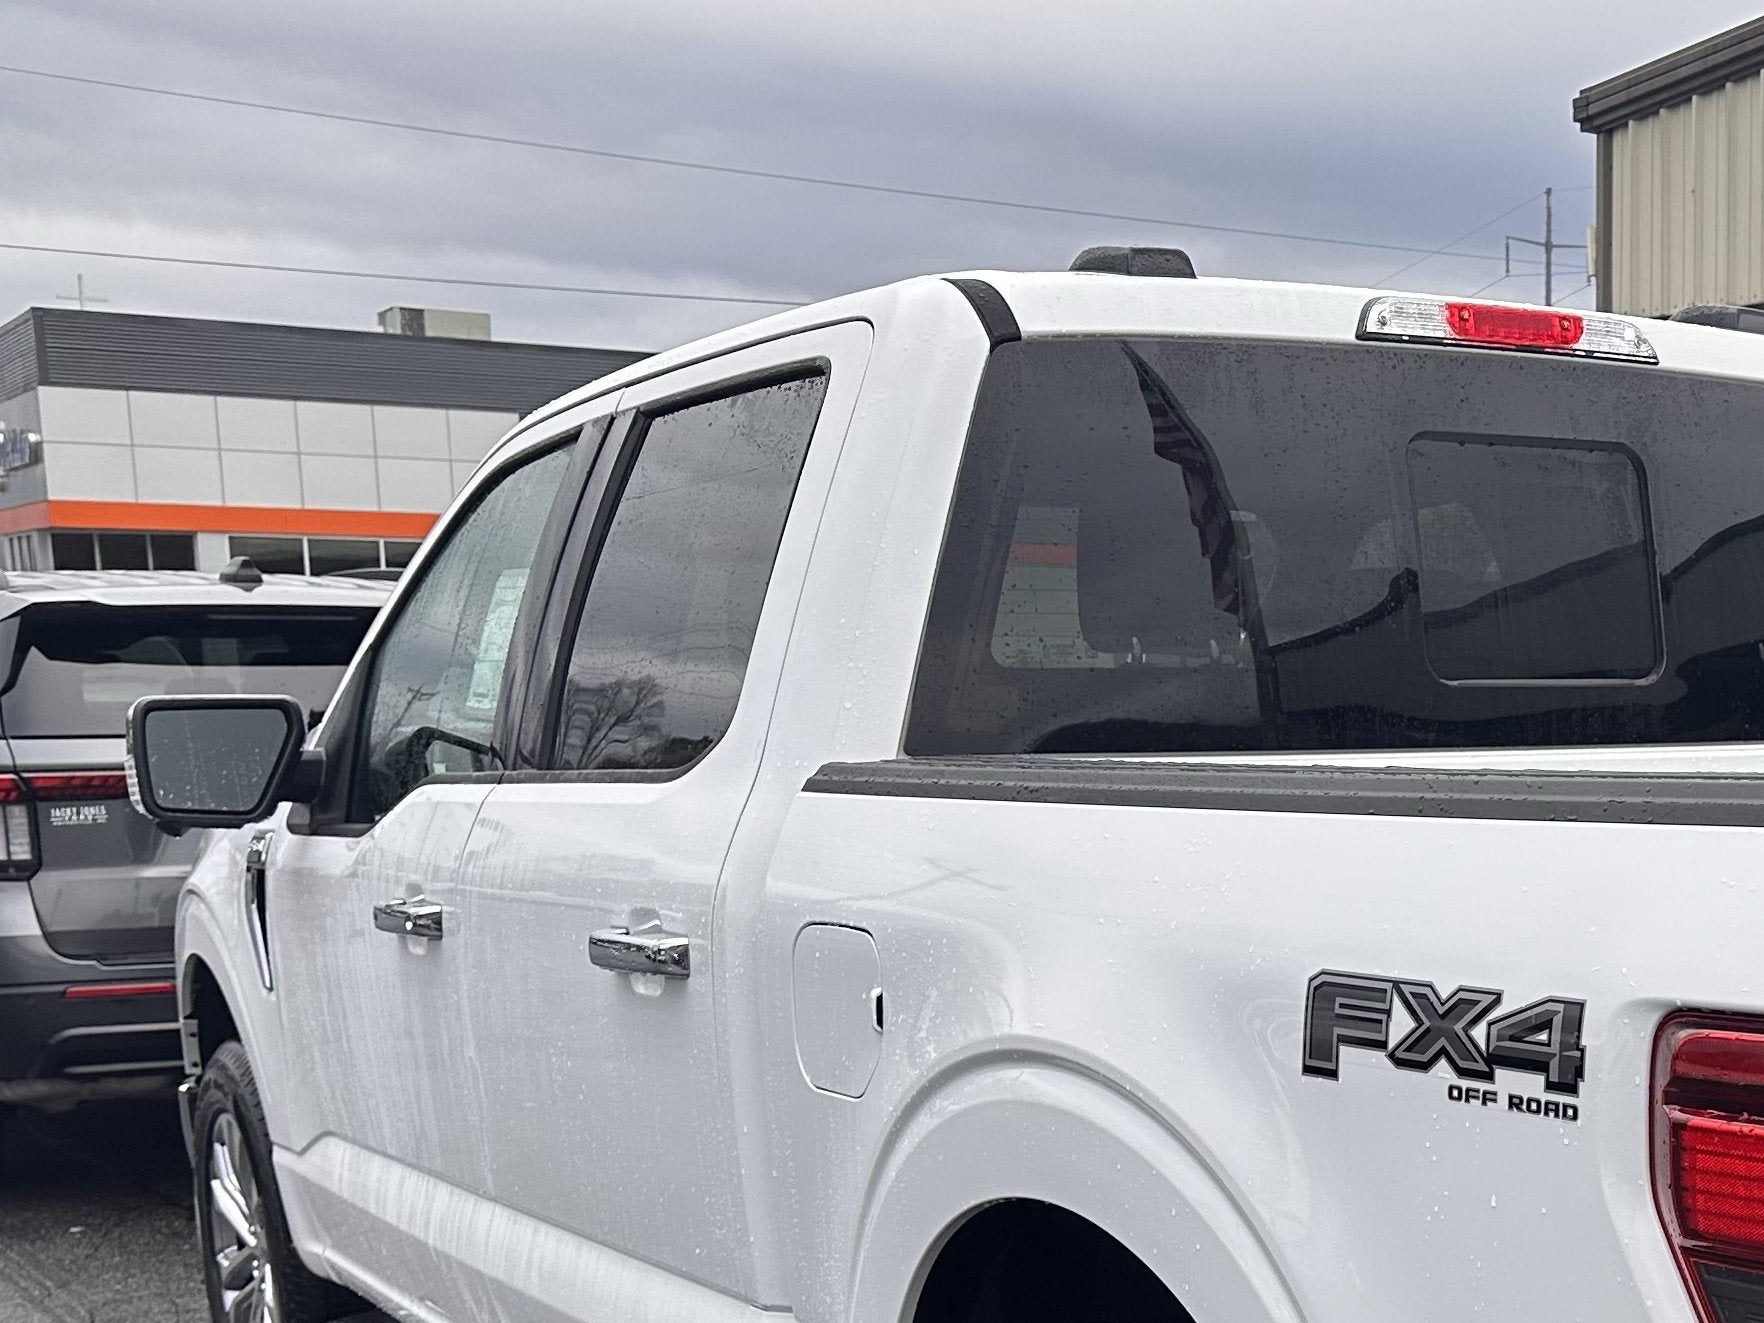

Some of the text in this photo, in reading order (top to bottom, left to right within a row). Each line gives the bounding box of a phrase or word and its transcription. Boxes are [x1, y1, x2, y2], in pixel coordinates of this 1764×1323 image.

[1301, 968, 1588, 1098] FX4
[1447, 1083, 1580, 1123] OFF ROAD
